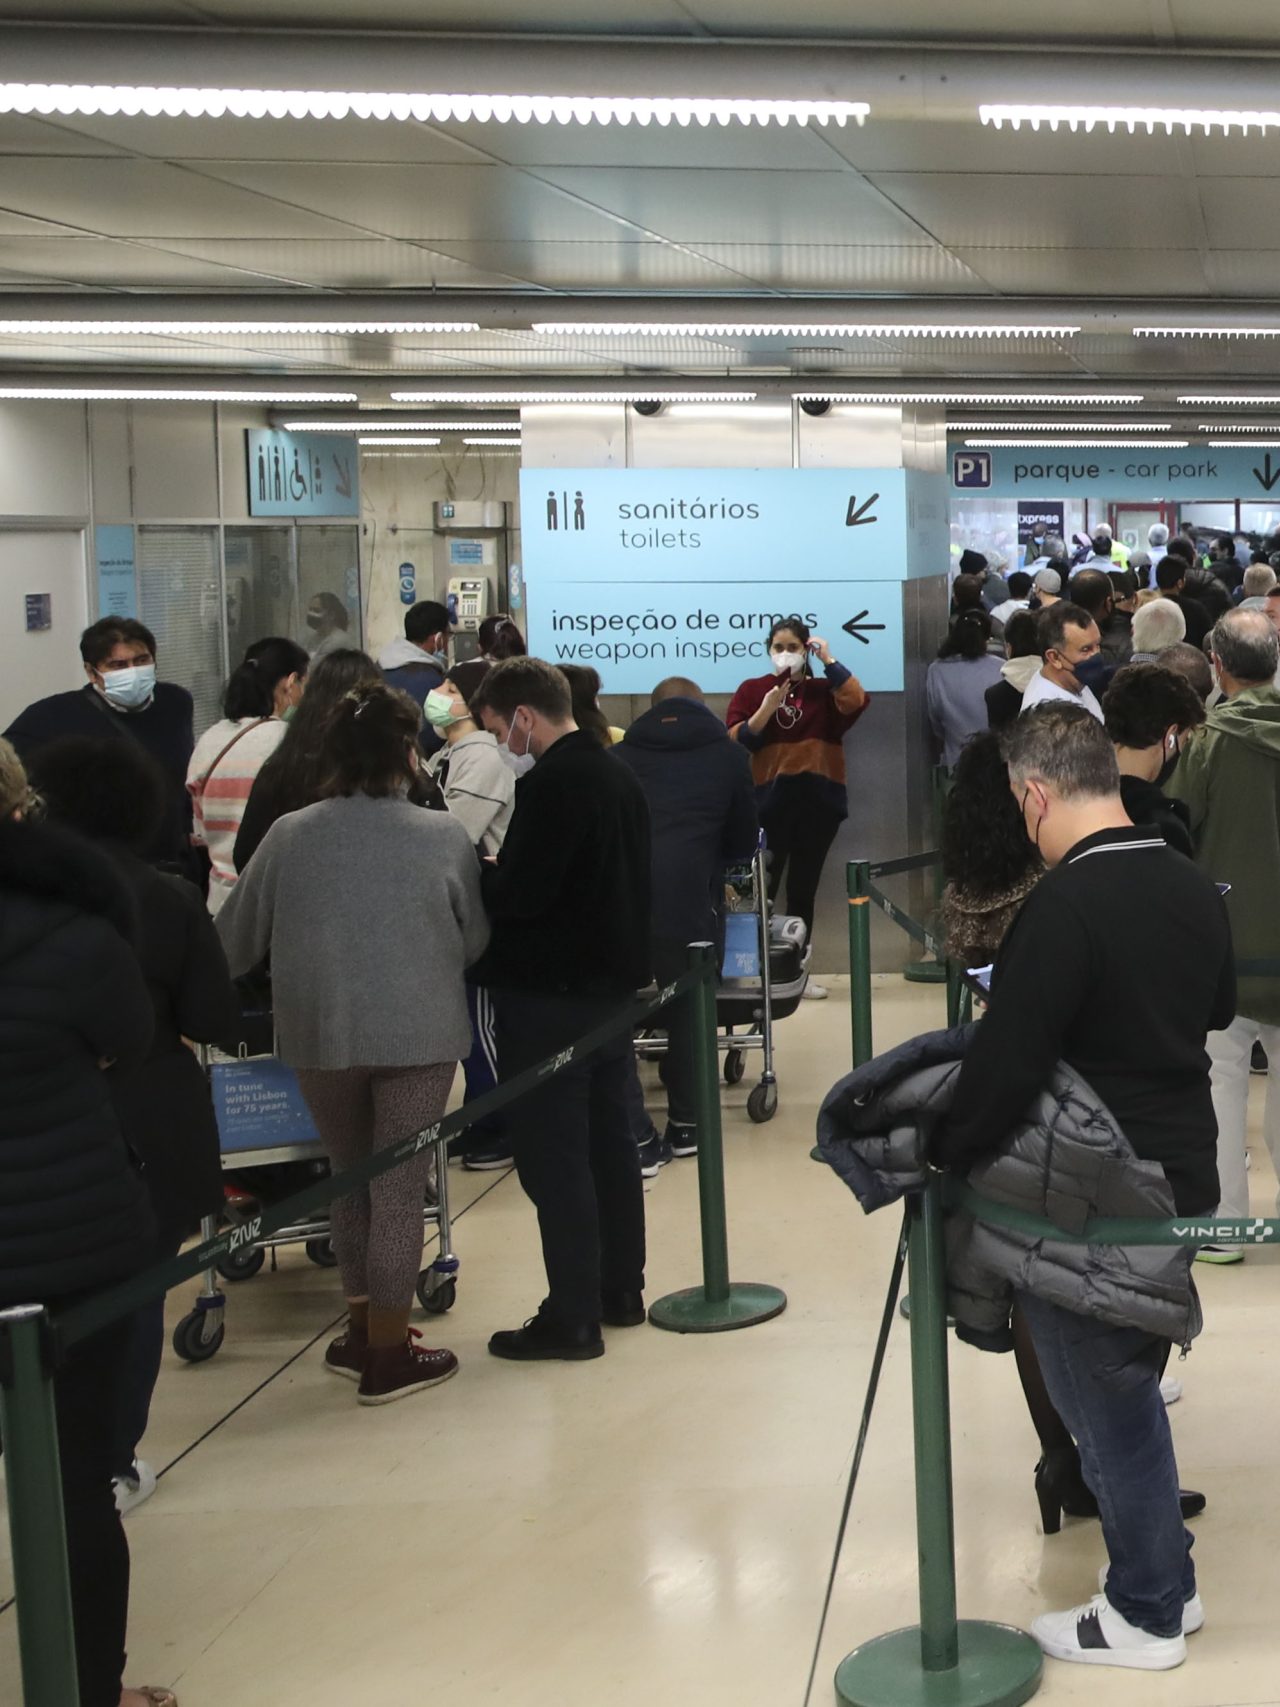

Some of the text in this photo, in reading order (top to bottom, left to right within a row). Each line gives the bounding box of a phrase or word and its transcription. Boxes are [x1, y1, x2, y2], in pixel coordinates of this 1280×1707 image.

[957, 458, 988, 482] P1
[1014, 462, 1100, 483] parque
[1124, 463, 1160, 478] car
[1168, 460, 1218, 481] park
[618, 497, 760, 520] sanitários
[619, 528, 701, 549] toilets
[552, 608, 678, 636] inspeção
[686, 608, 720, 631] de
[555, 637, 767, 664] weapon inspec
[225, 1083, 263, 1093] In tune
[225, 1090, 287, 1104] with Lisbon
[226, 1105, 241, 1115] for
[244, 1103, 257, 1113] 75
[1172, 1226, 1240, 1237] VINCI
